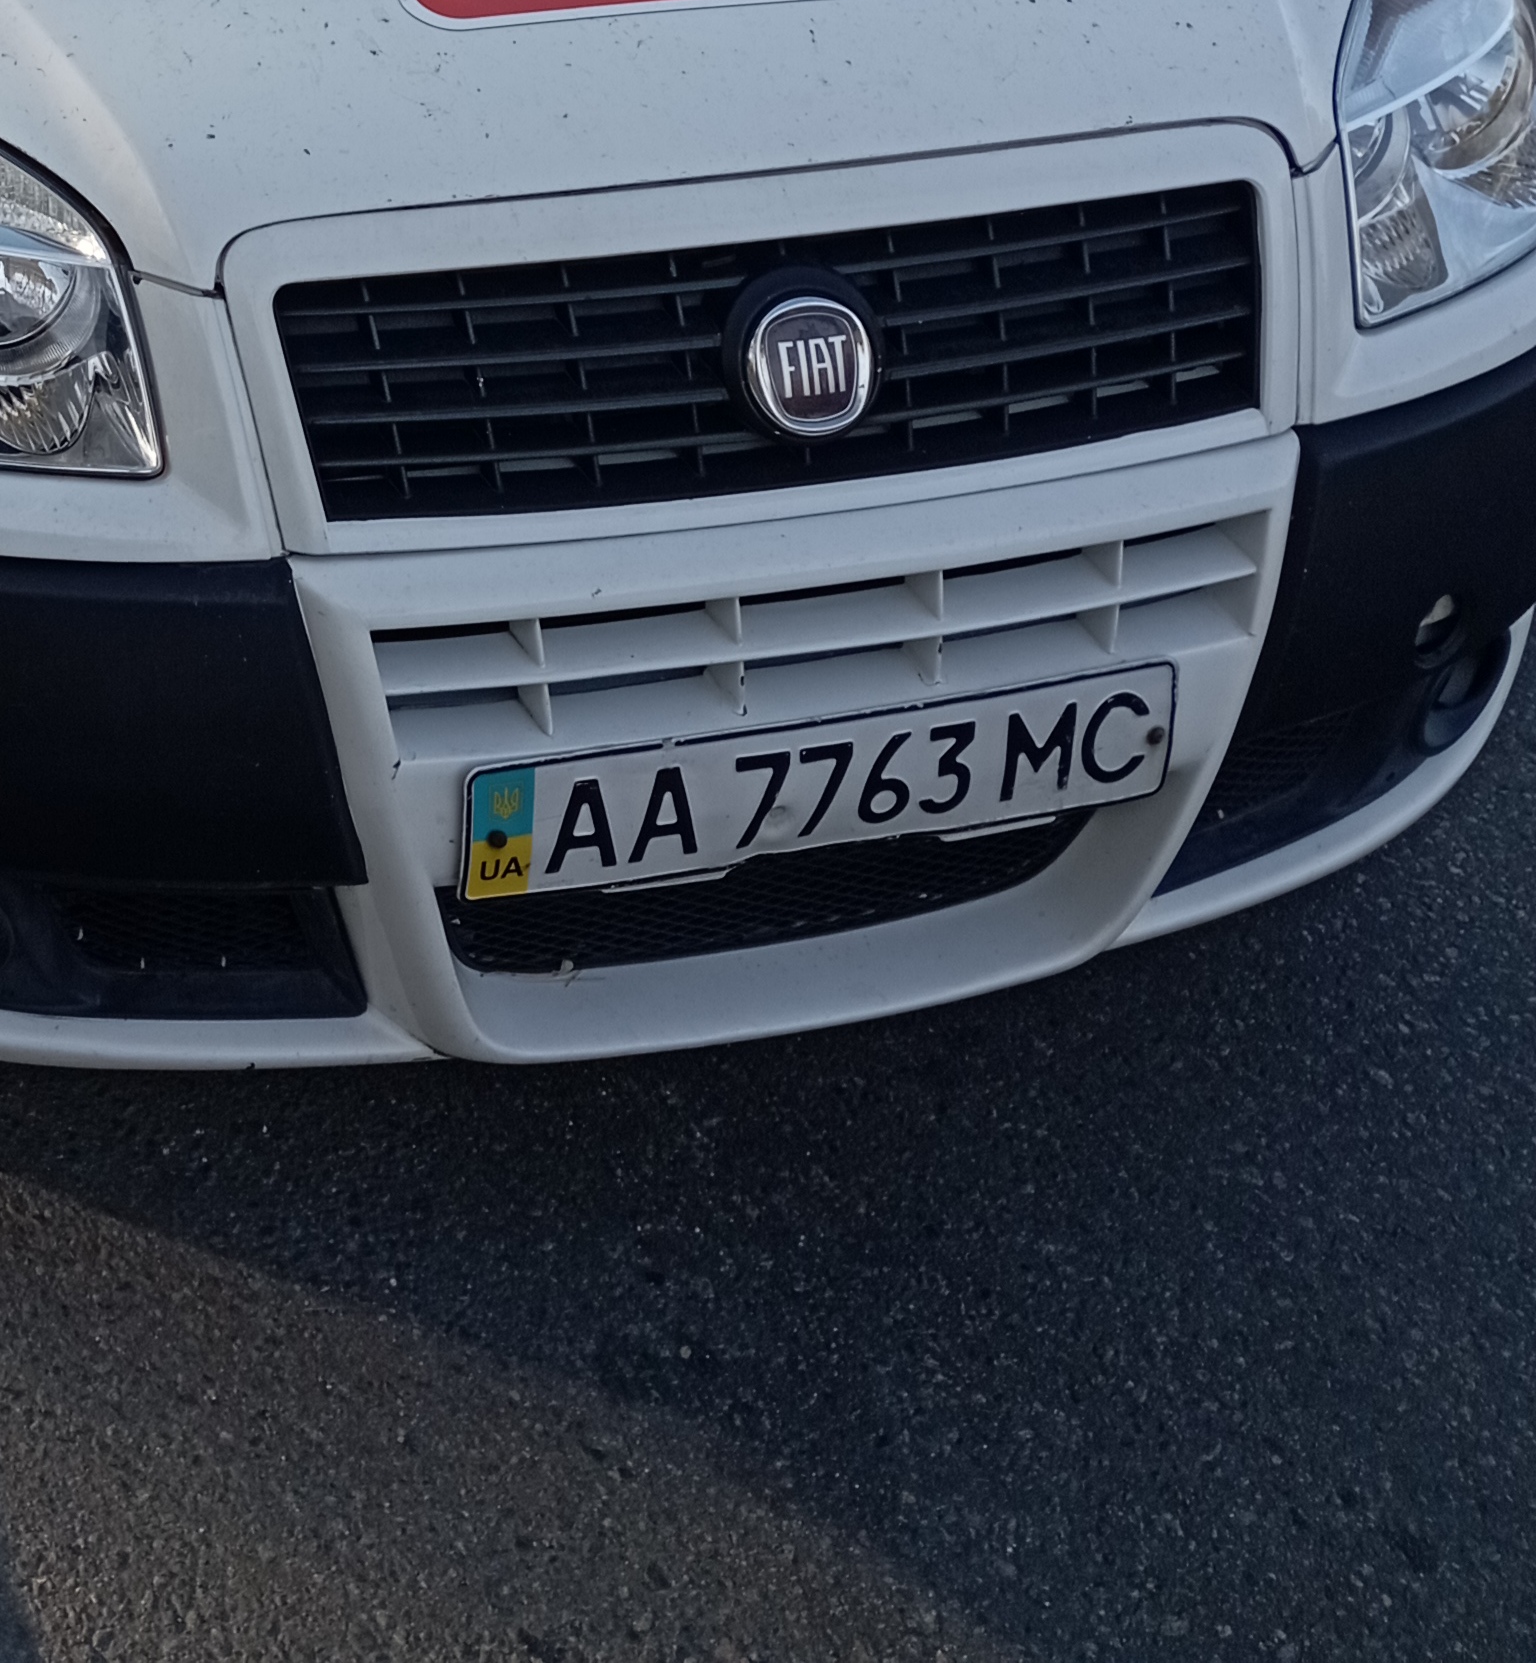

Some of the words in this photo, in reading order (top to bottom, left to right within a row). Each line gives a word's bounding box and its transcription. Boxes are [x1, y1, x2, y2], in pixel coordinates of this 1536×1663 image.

[777, 334, 848, 399] FIAT
[544, 767, 699, 876] AA
[735, 720, 977, 849] 7763
[999, 690, 1151, 803] MC
[480, 856, 524, 881] UA
